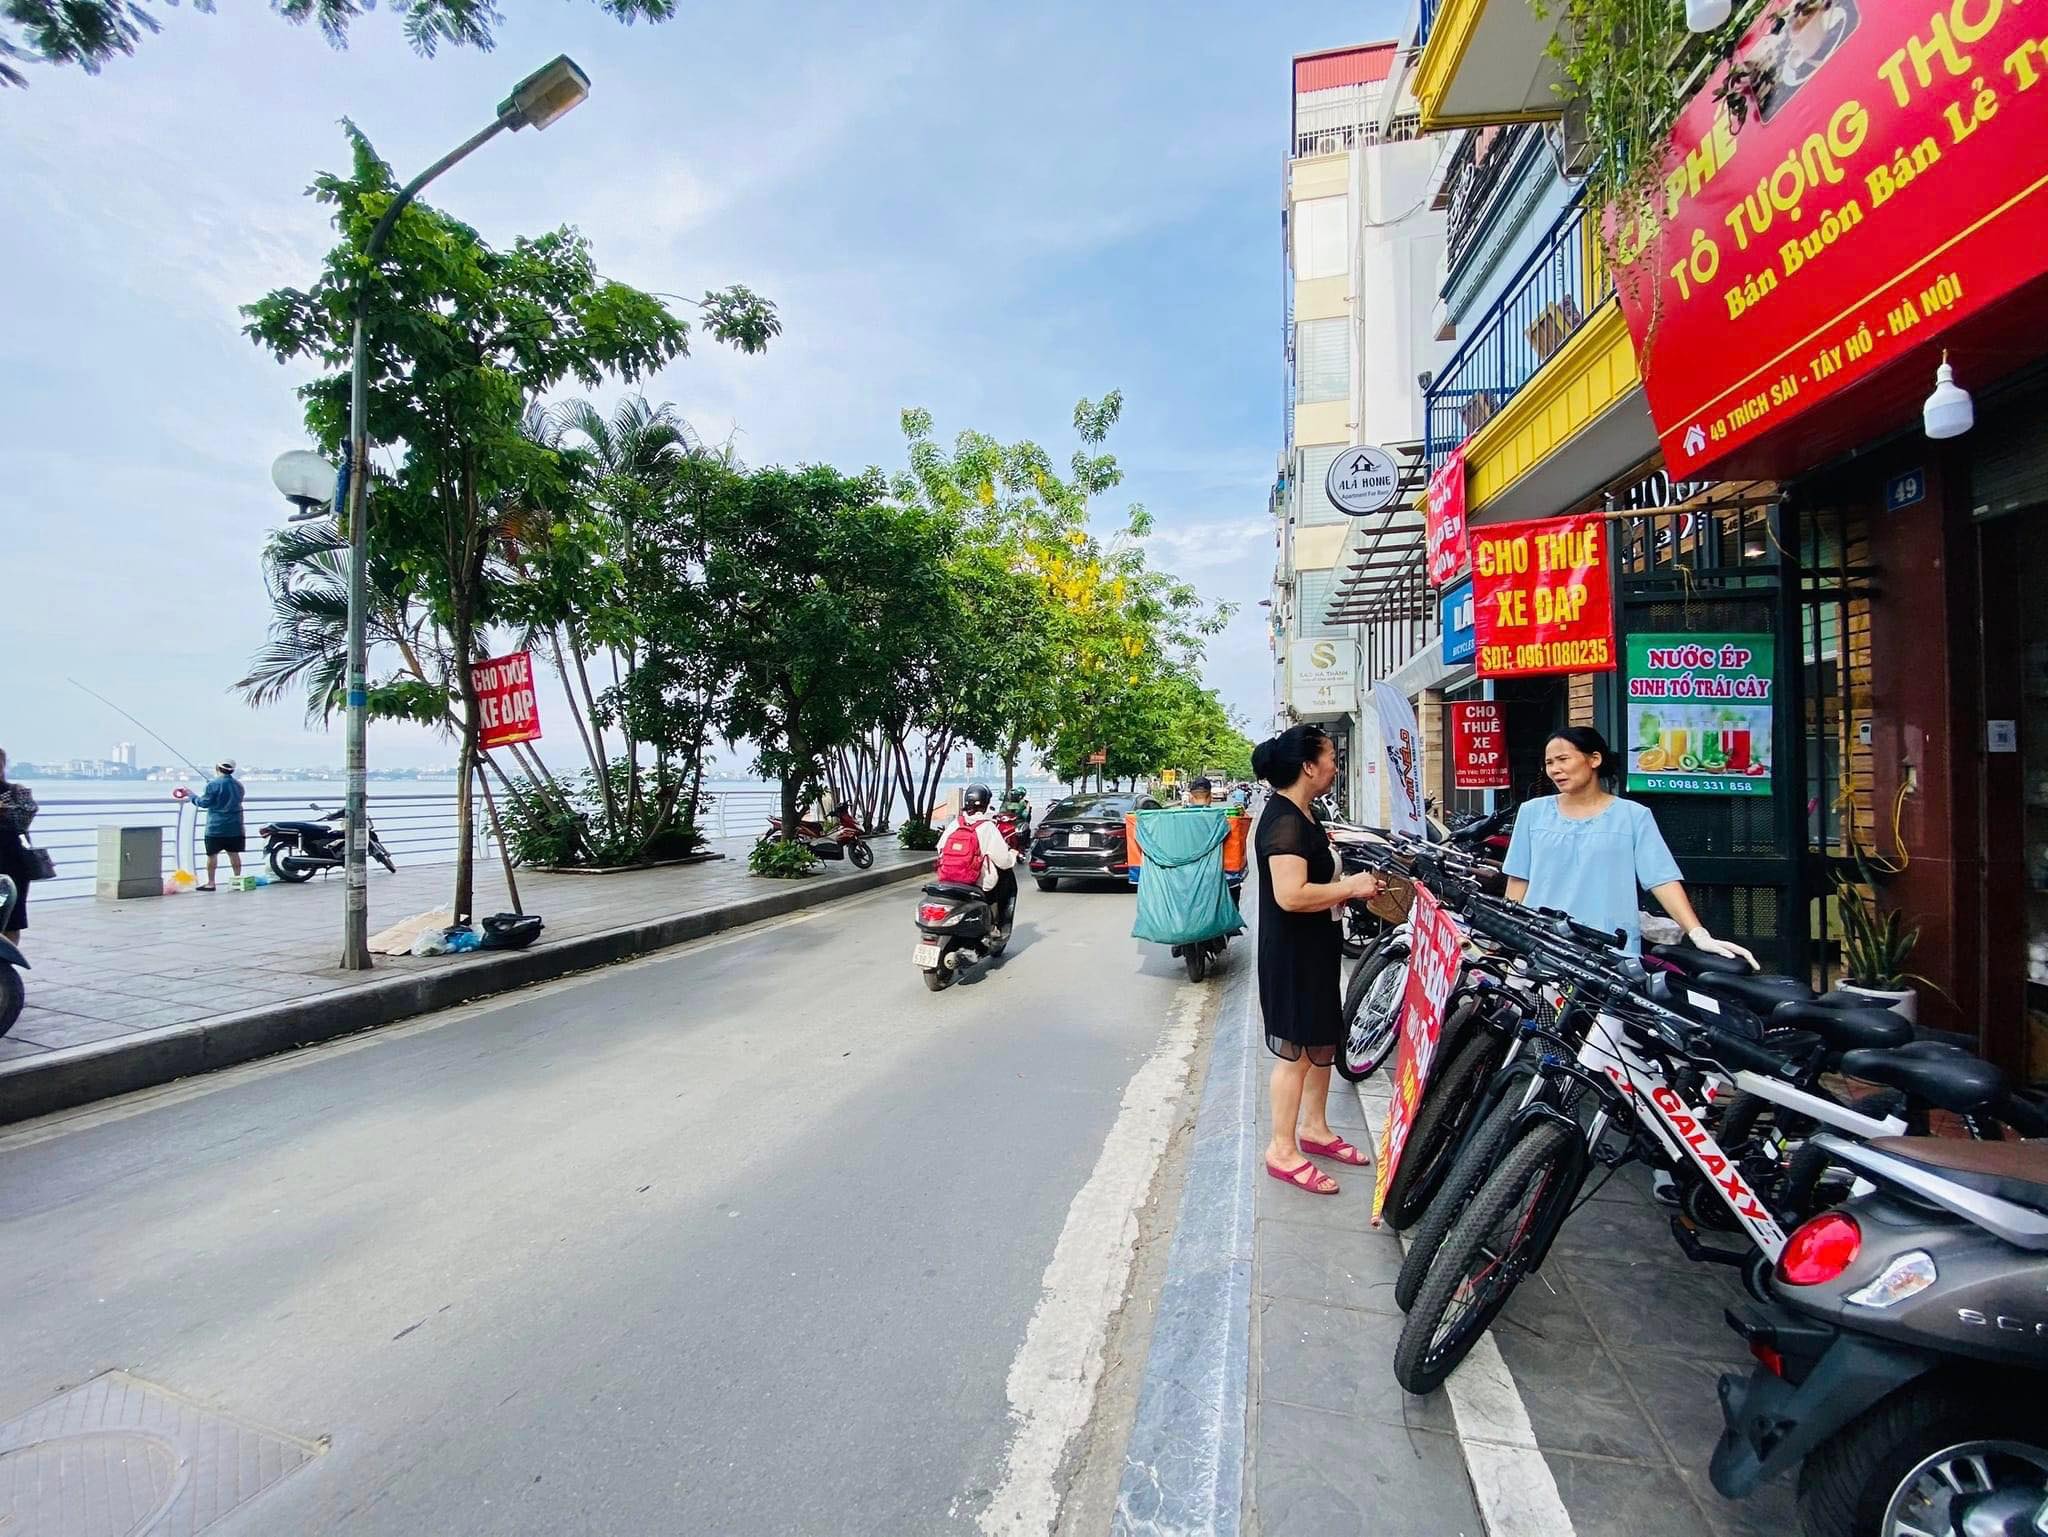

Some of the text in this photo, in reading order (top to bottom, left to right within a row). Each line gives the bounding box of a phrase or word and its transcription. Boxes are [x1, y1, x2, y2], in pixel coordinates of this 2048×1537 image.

[1670, 228, 1720, 300] TÔ
[1725, 100, 1869, 250] TƯỢNG
[1724, 273, 1779, 321] Bán
[1779, 199, 1864, 277] Buôn
[1864, 136, 1942, 208] Bán
[1943, 76, 1999, 145] Lẻ
[1710, 418, 1727, 441] 49
[1727, 392, 1771, 431] TRÍCH
[1770, 373, 1800, 406] SÀI
[1809, 346, 1843, 382] TÂY
[1844, 320, 1873, 362] HỒ
[1887, 297, 1921, 336] HÀ
[1920, 271, 1963, 317] NỘI
[1362, 475, 1391, 488] HOME
[1895, 477, 1918, 502] 49
[1478, 536, 1528, 577] CHO
[1535, 522, 1599, 571] THUÊ
[1496, 583, 1588, 631] XE ĐẠP
[1516, 637, 1608, 669] 0961080235
[1648, 643, 1752, 669] NƯỚC ÉP
[472, 666, 499, 693] CHO
[1630, 671, 1770, 698] SINH TỐ TRÁI CÂY
[479, 689, 533, 729] XE ĐẠP
[1465, 705, 1496, 718] CHO
[1461, 718, 1500, 734] THUÊ
[1473, 737, 1491, 749] XE
[1468, 752, 1498, 766] ĐẠP
[1647, 779, 1752, 792] ĐT: 0988 331 858
[1651, 1087, 1769, 1221] GALAXY
